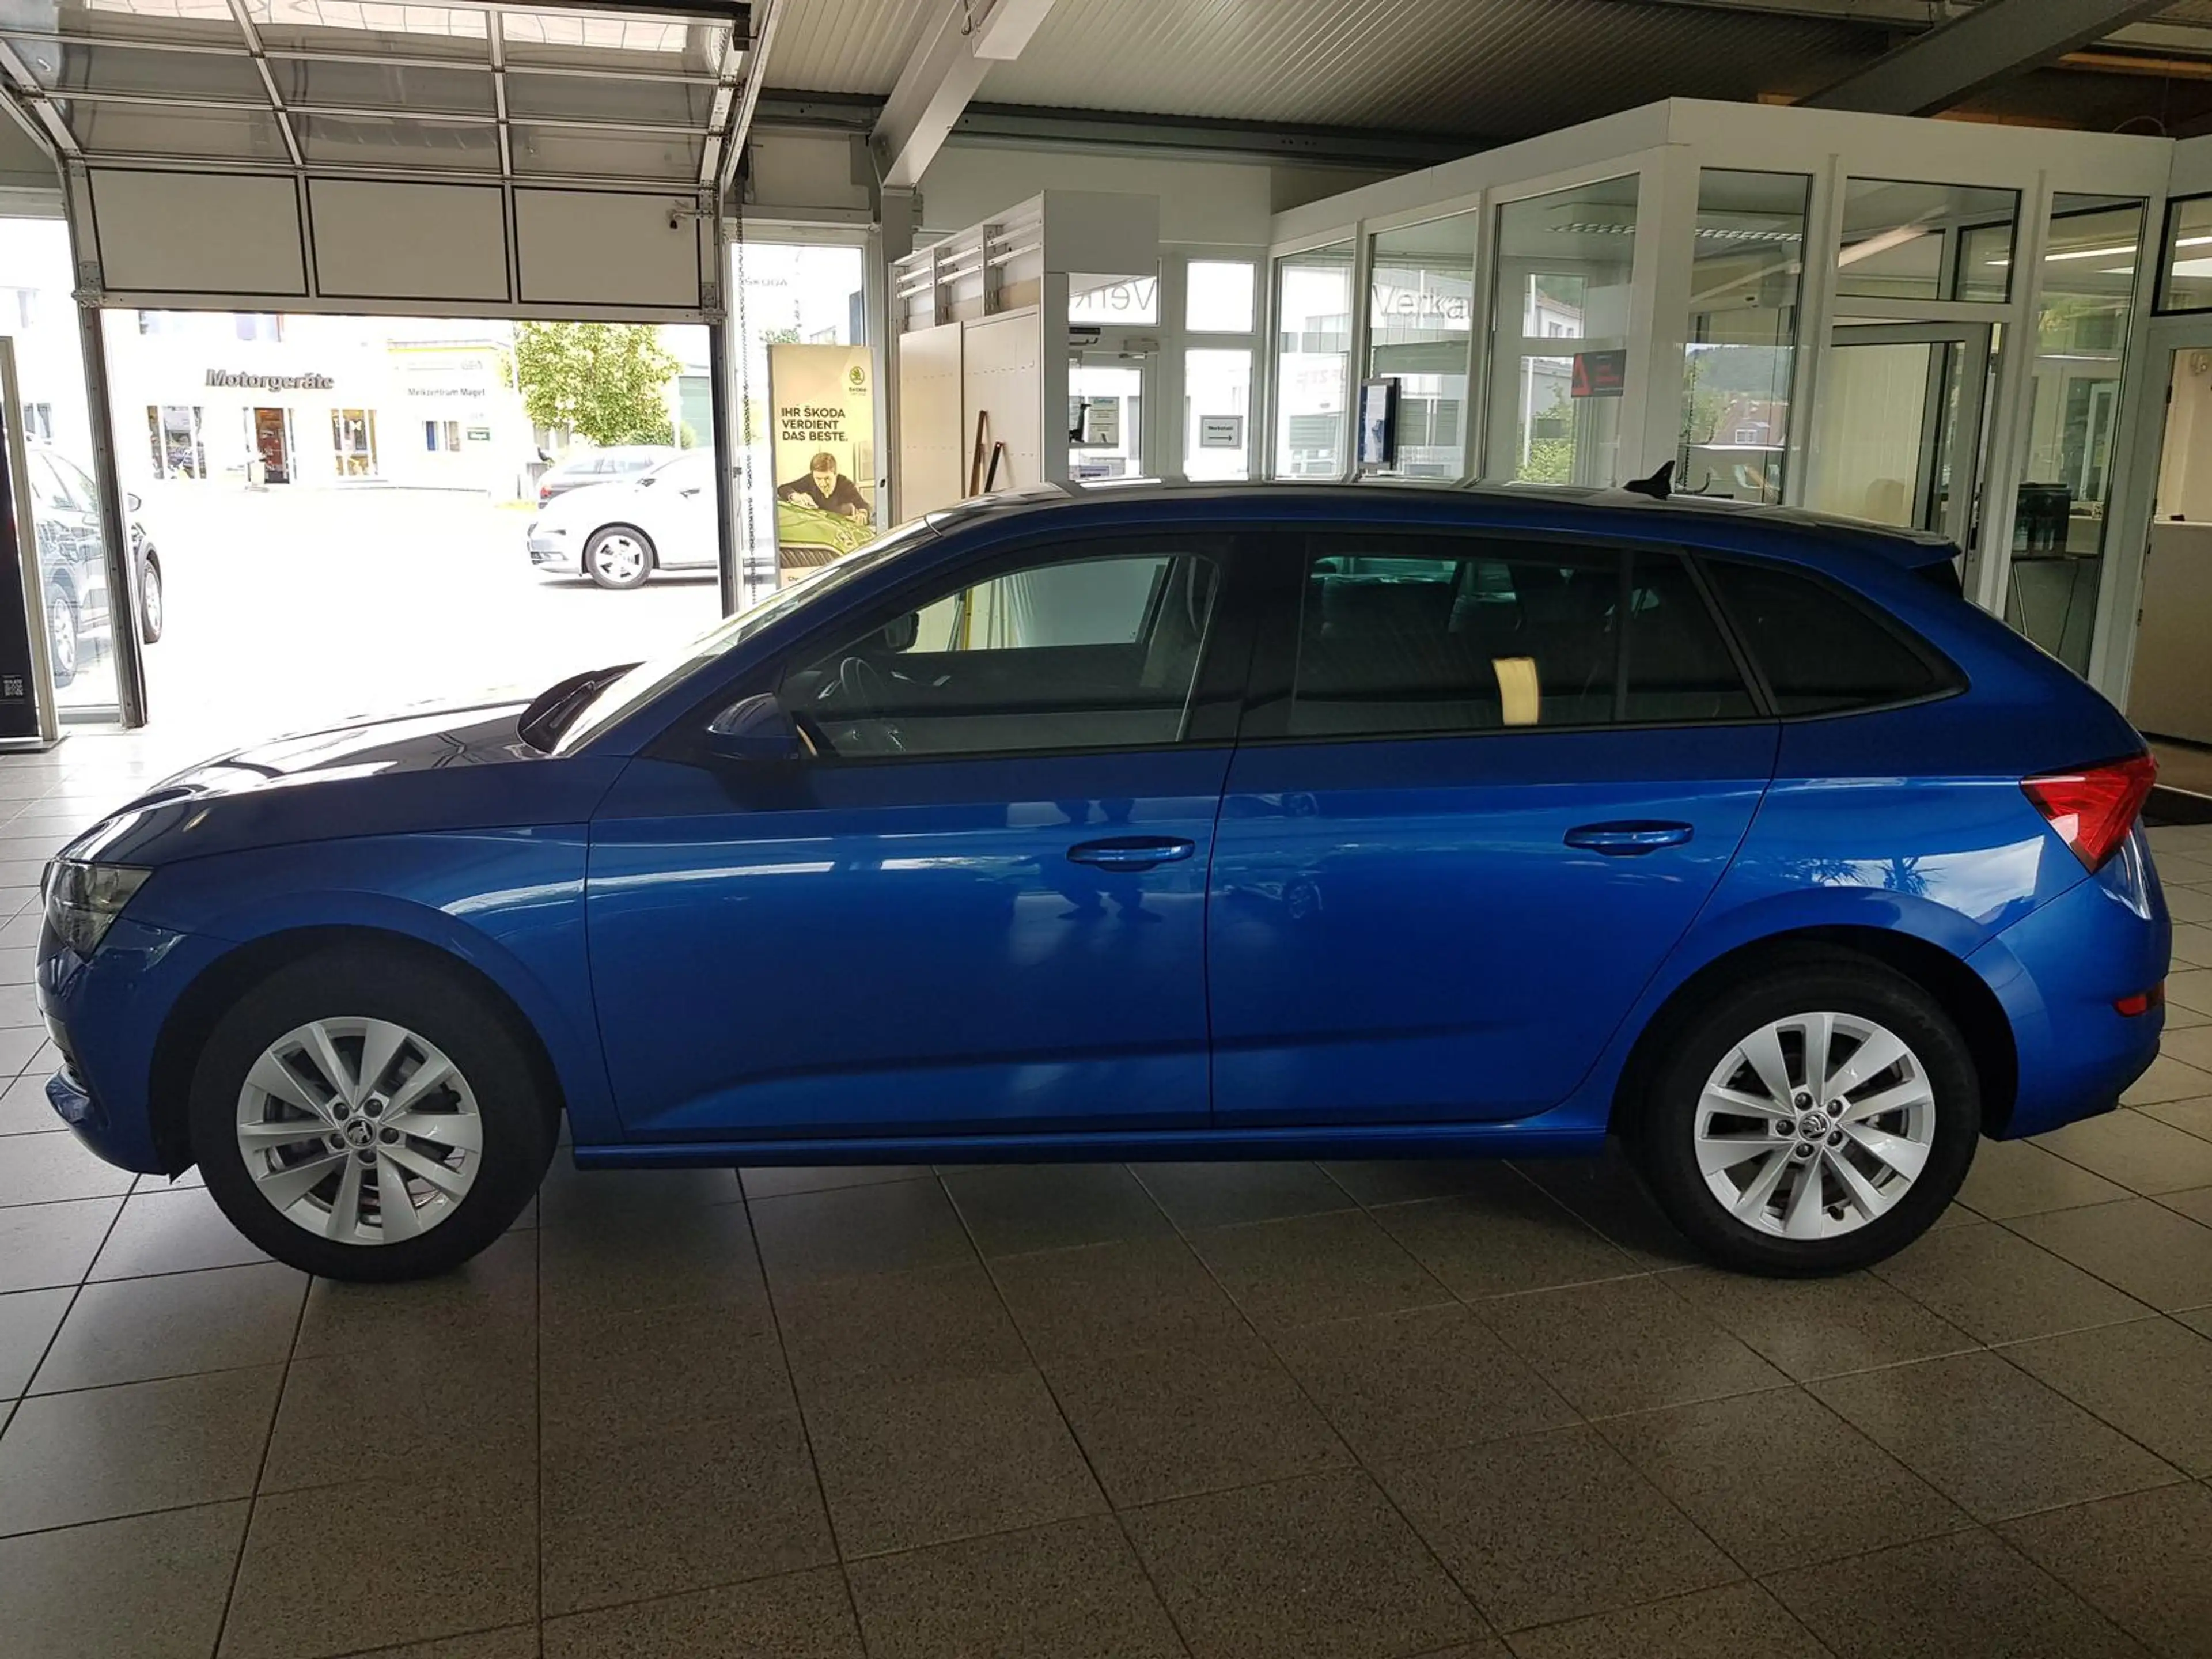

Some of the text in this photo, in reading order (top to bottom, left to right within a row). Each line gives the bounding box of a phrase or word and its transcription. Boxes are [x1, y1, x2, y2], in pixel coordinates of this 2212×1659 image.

[1372, 284, 1471, 319] Verka
[205, 368, 335, 393] Motorgeräte
[781, 404, 846, 418] IHR ŠKODA
[782, 419, 839, 430] VERDIENT
[782, 431, 849, 442] DAS BESTE.
